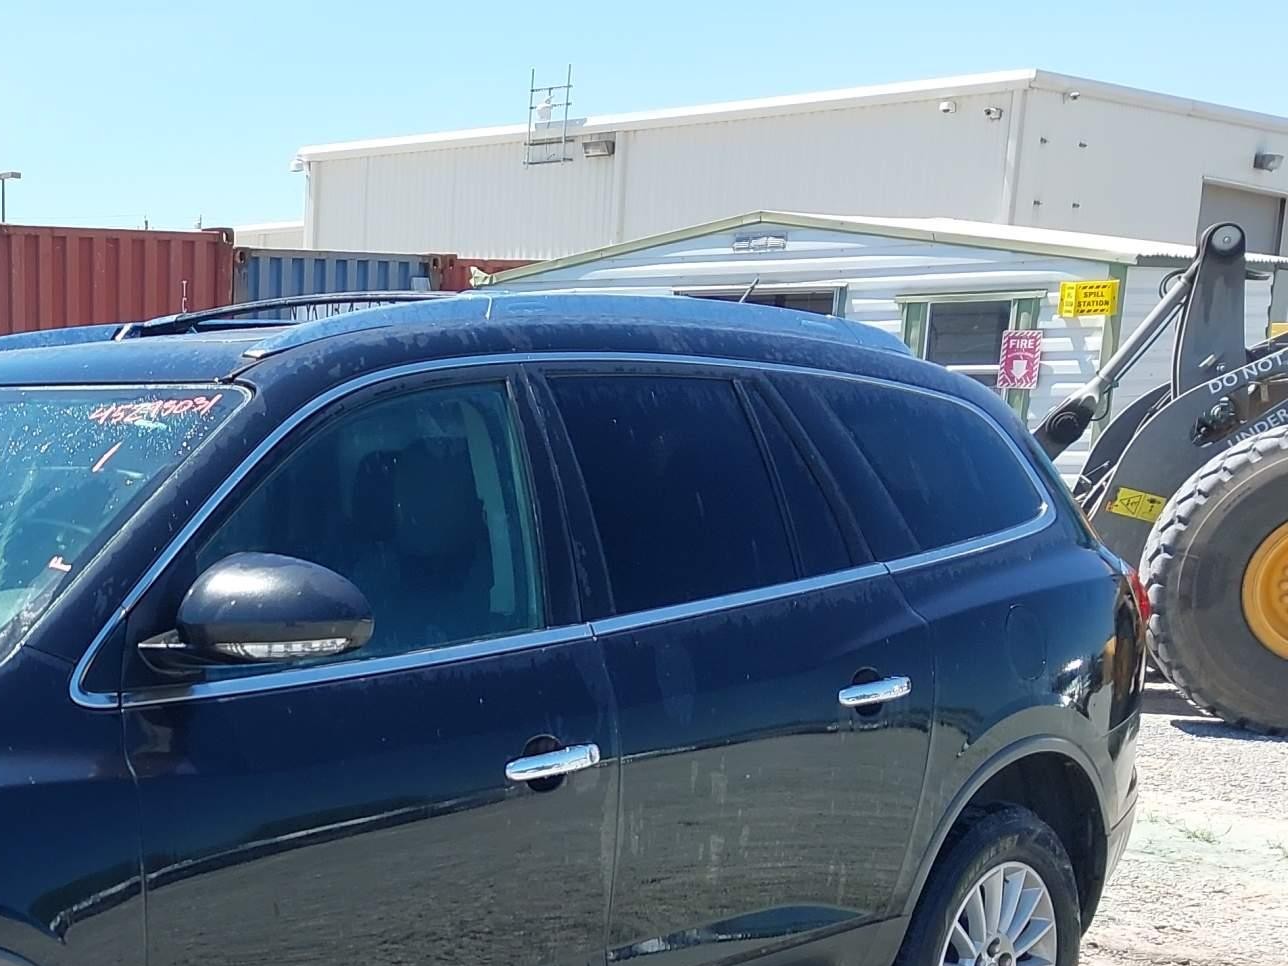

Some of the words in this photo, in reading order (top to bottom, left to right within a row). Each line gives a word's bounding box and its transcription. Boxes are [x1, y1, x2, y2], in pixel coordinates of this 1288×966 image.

[1083, 291, 1105, 299] SPILL
[1077, 300, 1110, 308] STATION
[1009, 338, 1035, 349] FIRE
[1208, 373, 1238, 394] DO
[1242, 354, 1283, 379] NOT
